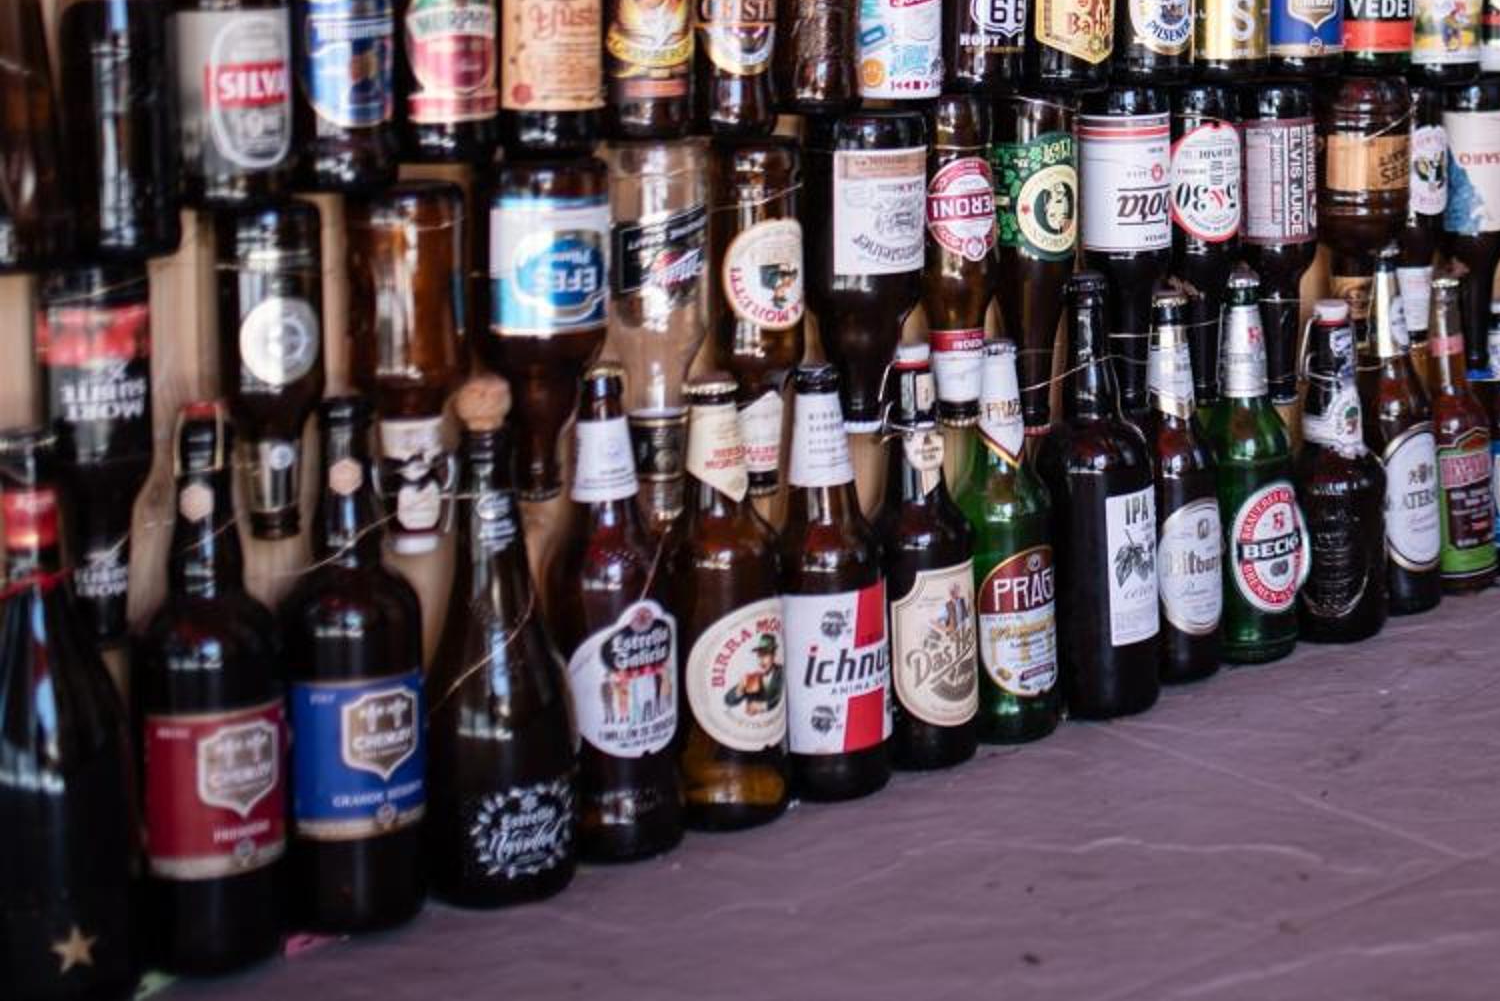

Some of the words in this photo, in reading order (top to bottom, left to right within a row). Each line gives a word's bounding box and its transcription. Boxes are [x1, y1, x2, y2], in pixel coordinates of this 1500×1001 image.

[1290, 126, 1302, 179] ELVIS
[933, 196, 994, 219] ERONI
[1290, 183, 1302, 236] JUICE
[1123, 495, 1150, 526] IPA
